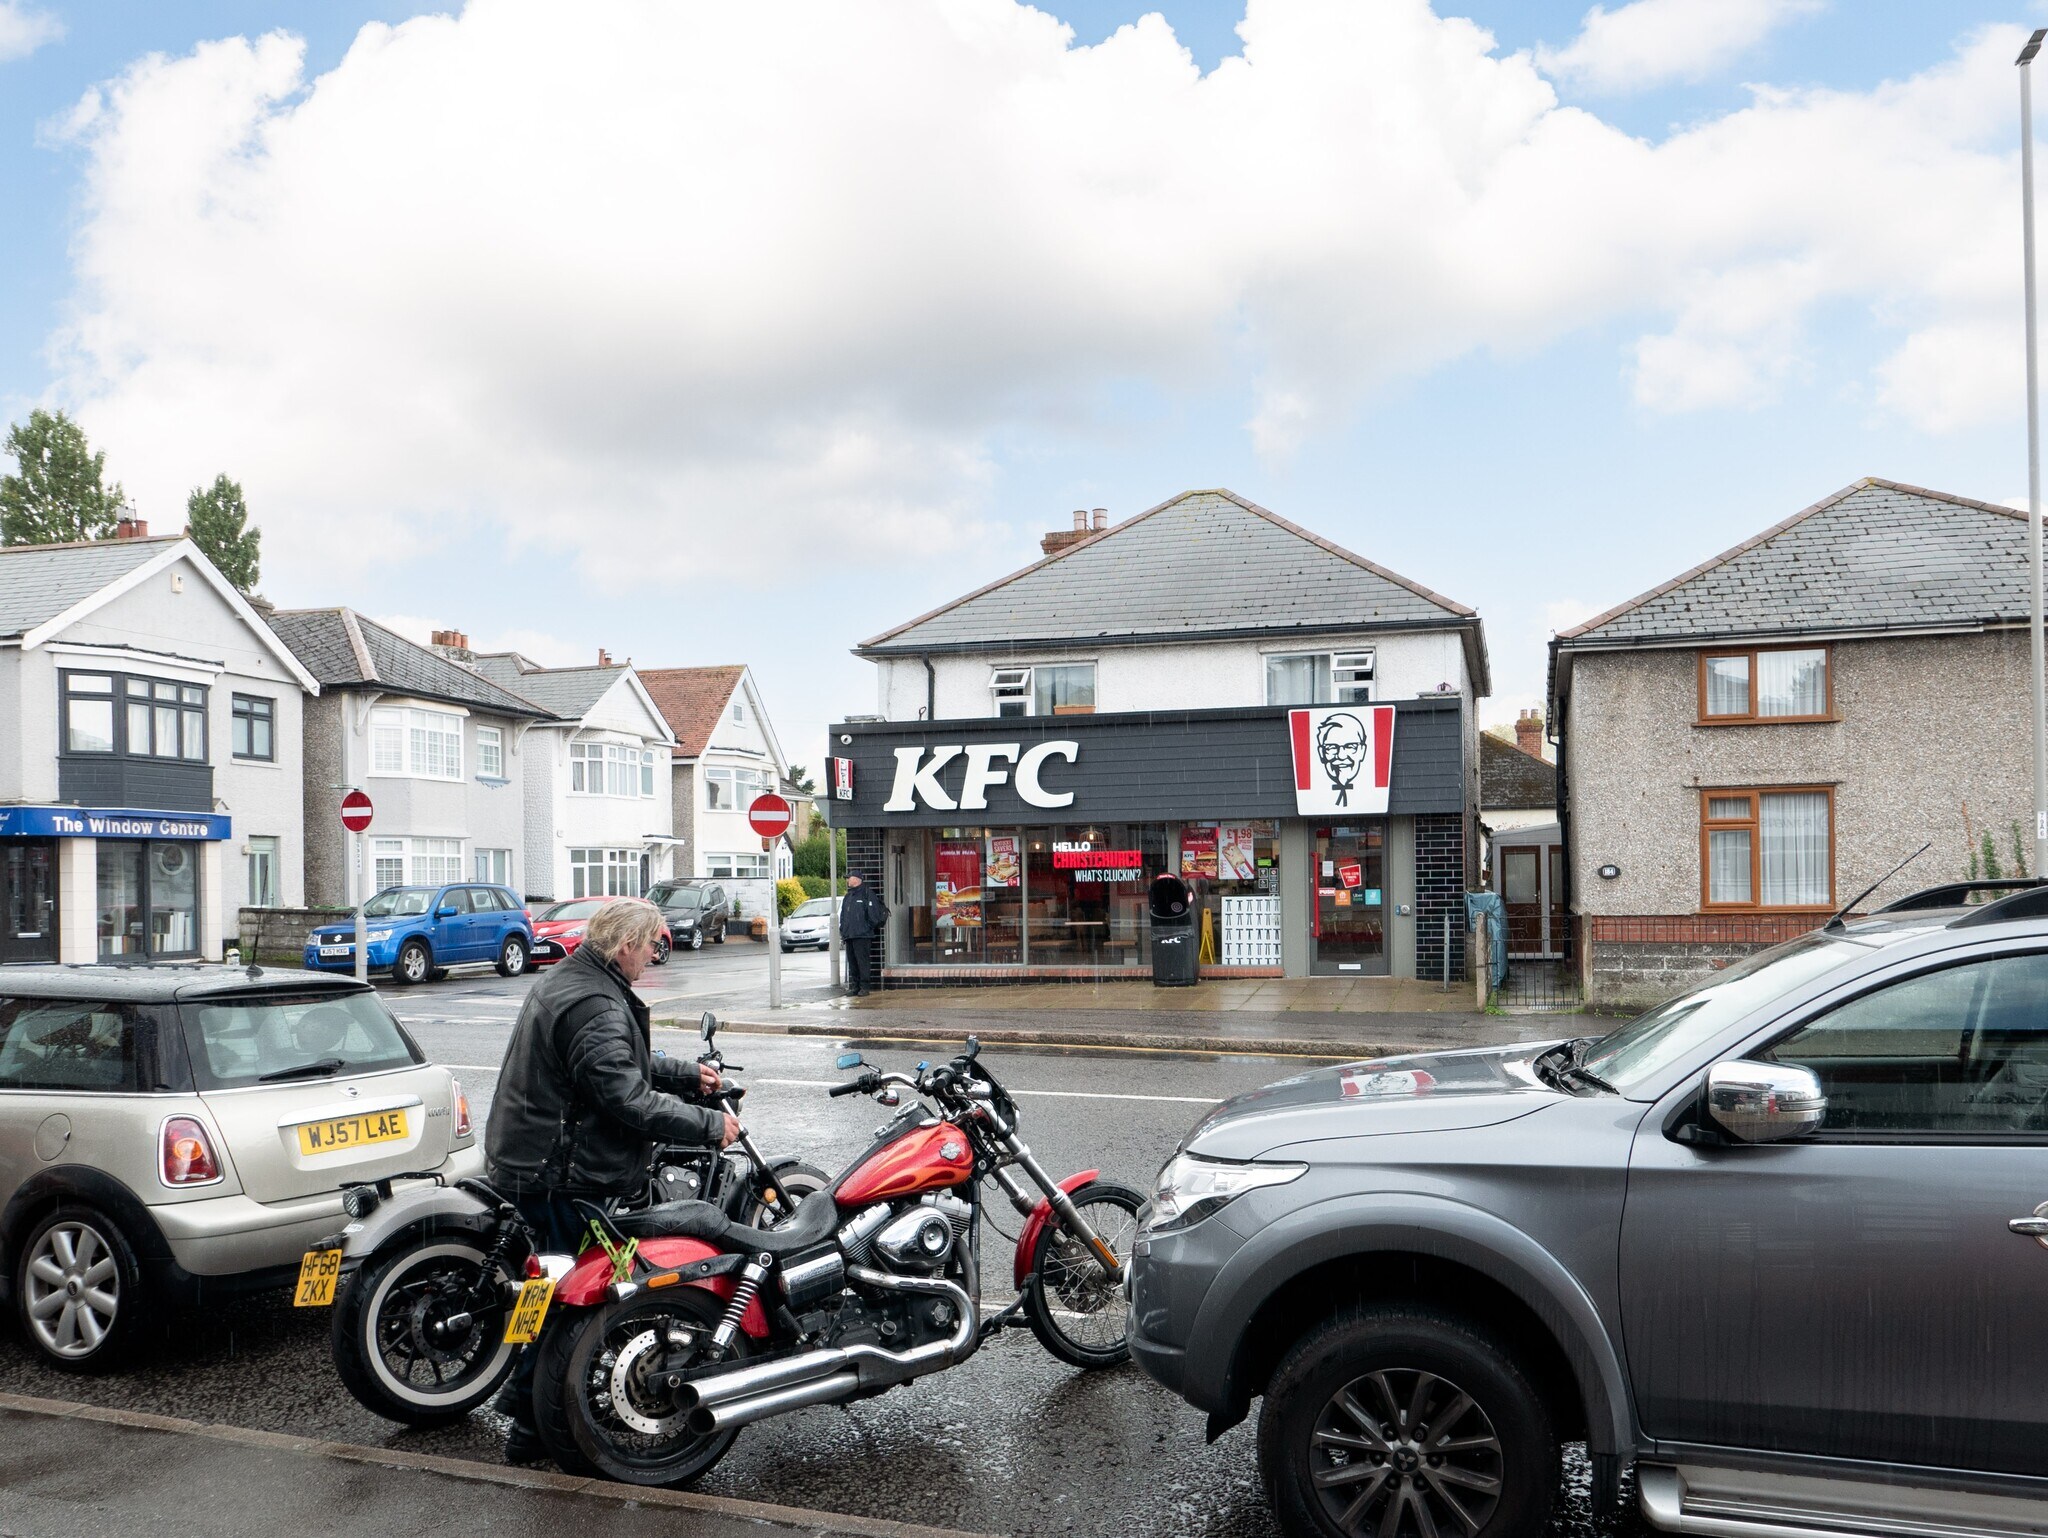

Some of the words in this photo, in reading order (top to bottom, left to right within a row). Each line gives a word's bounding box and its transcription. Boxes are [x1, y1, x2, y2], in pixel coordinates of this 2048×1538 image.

[883, 740, 1079, 812] KFC
[839, 789, 851, 799] KFC
[52, 816, 83, 833] The
[89, 818, 153, 835] Window
[160, 820, 208, 837] Centre
[1052, 841, 1091, 852] HELLO
[1226, 828, 1252, 846] £1.98
[994, 845, 1013, 853] SAVERS
[1053, 850, 1142, 869] CHRISTCHURCH
[1075, 870, 1102, 882] WHAT'S
[1103, 869, 1141, 882] CLUCKIN'?
[307, 1120, 360, 1149] WJ57
[365, 1114, 402, 1139] LAE
[301, 1253, 339, 1278] HF68
[300, 1278, 330, 1303] ZKX
[511, 1309, 540, 1335] NHB
